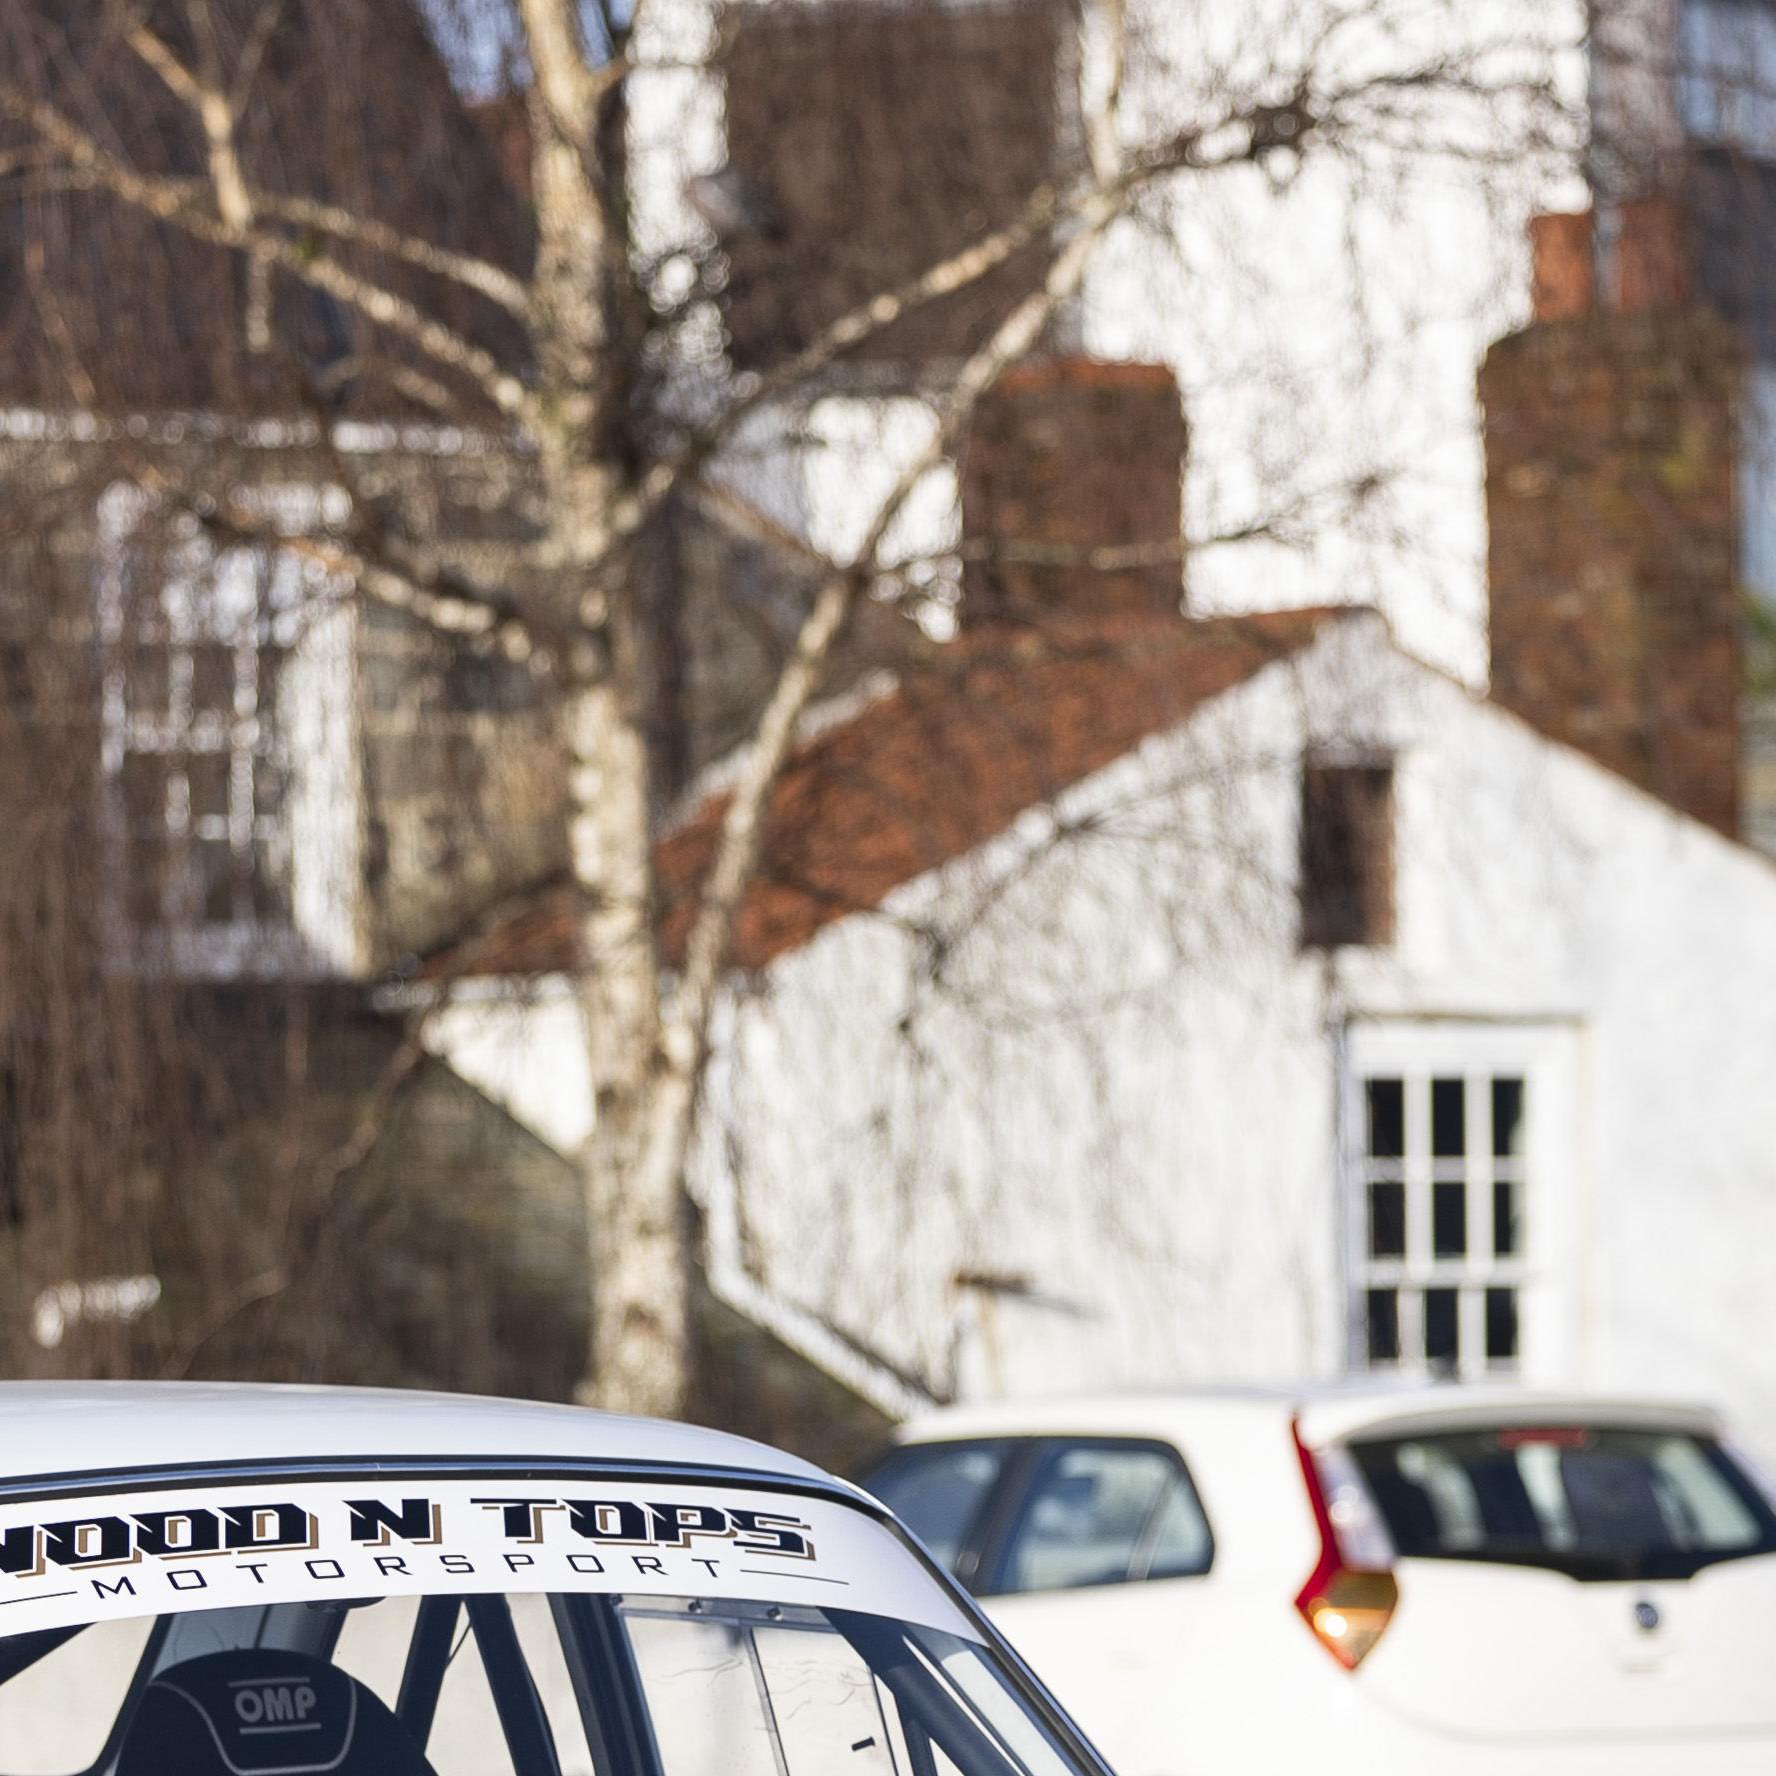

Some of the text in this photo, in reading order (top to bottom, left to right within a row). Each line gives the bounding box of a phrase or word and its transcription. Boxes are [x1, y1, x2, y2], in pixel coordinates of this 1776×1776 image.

[342, 1498, 443, 1546] N
[470, 1498, 817, 1562] TOPS
[91, 1554, 720, 1600] MOTORSPORT
[235, 1686, 316, 1722] OMP
